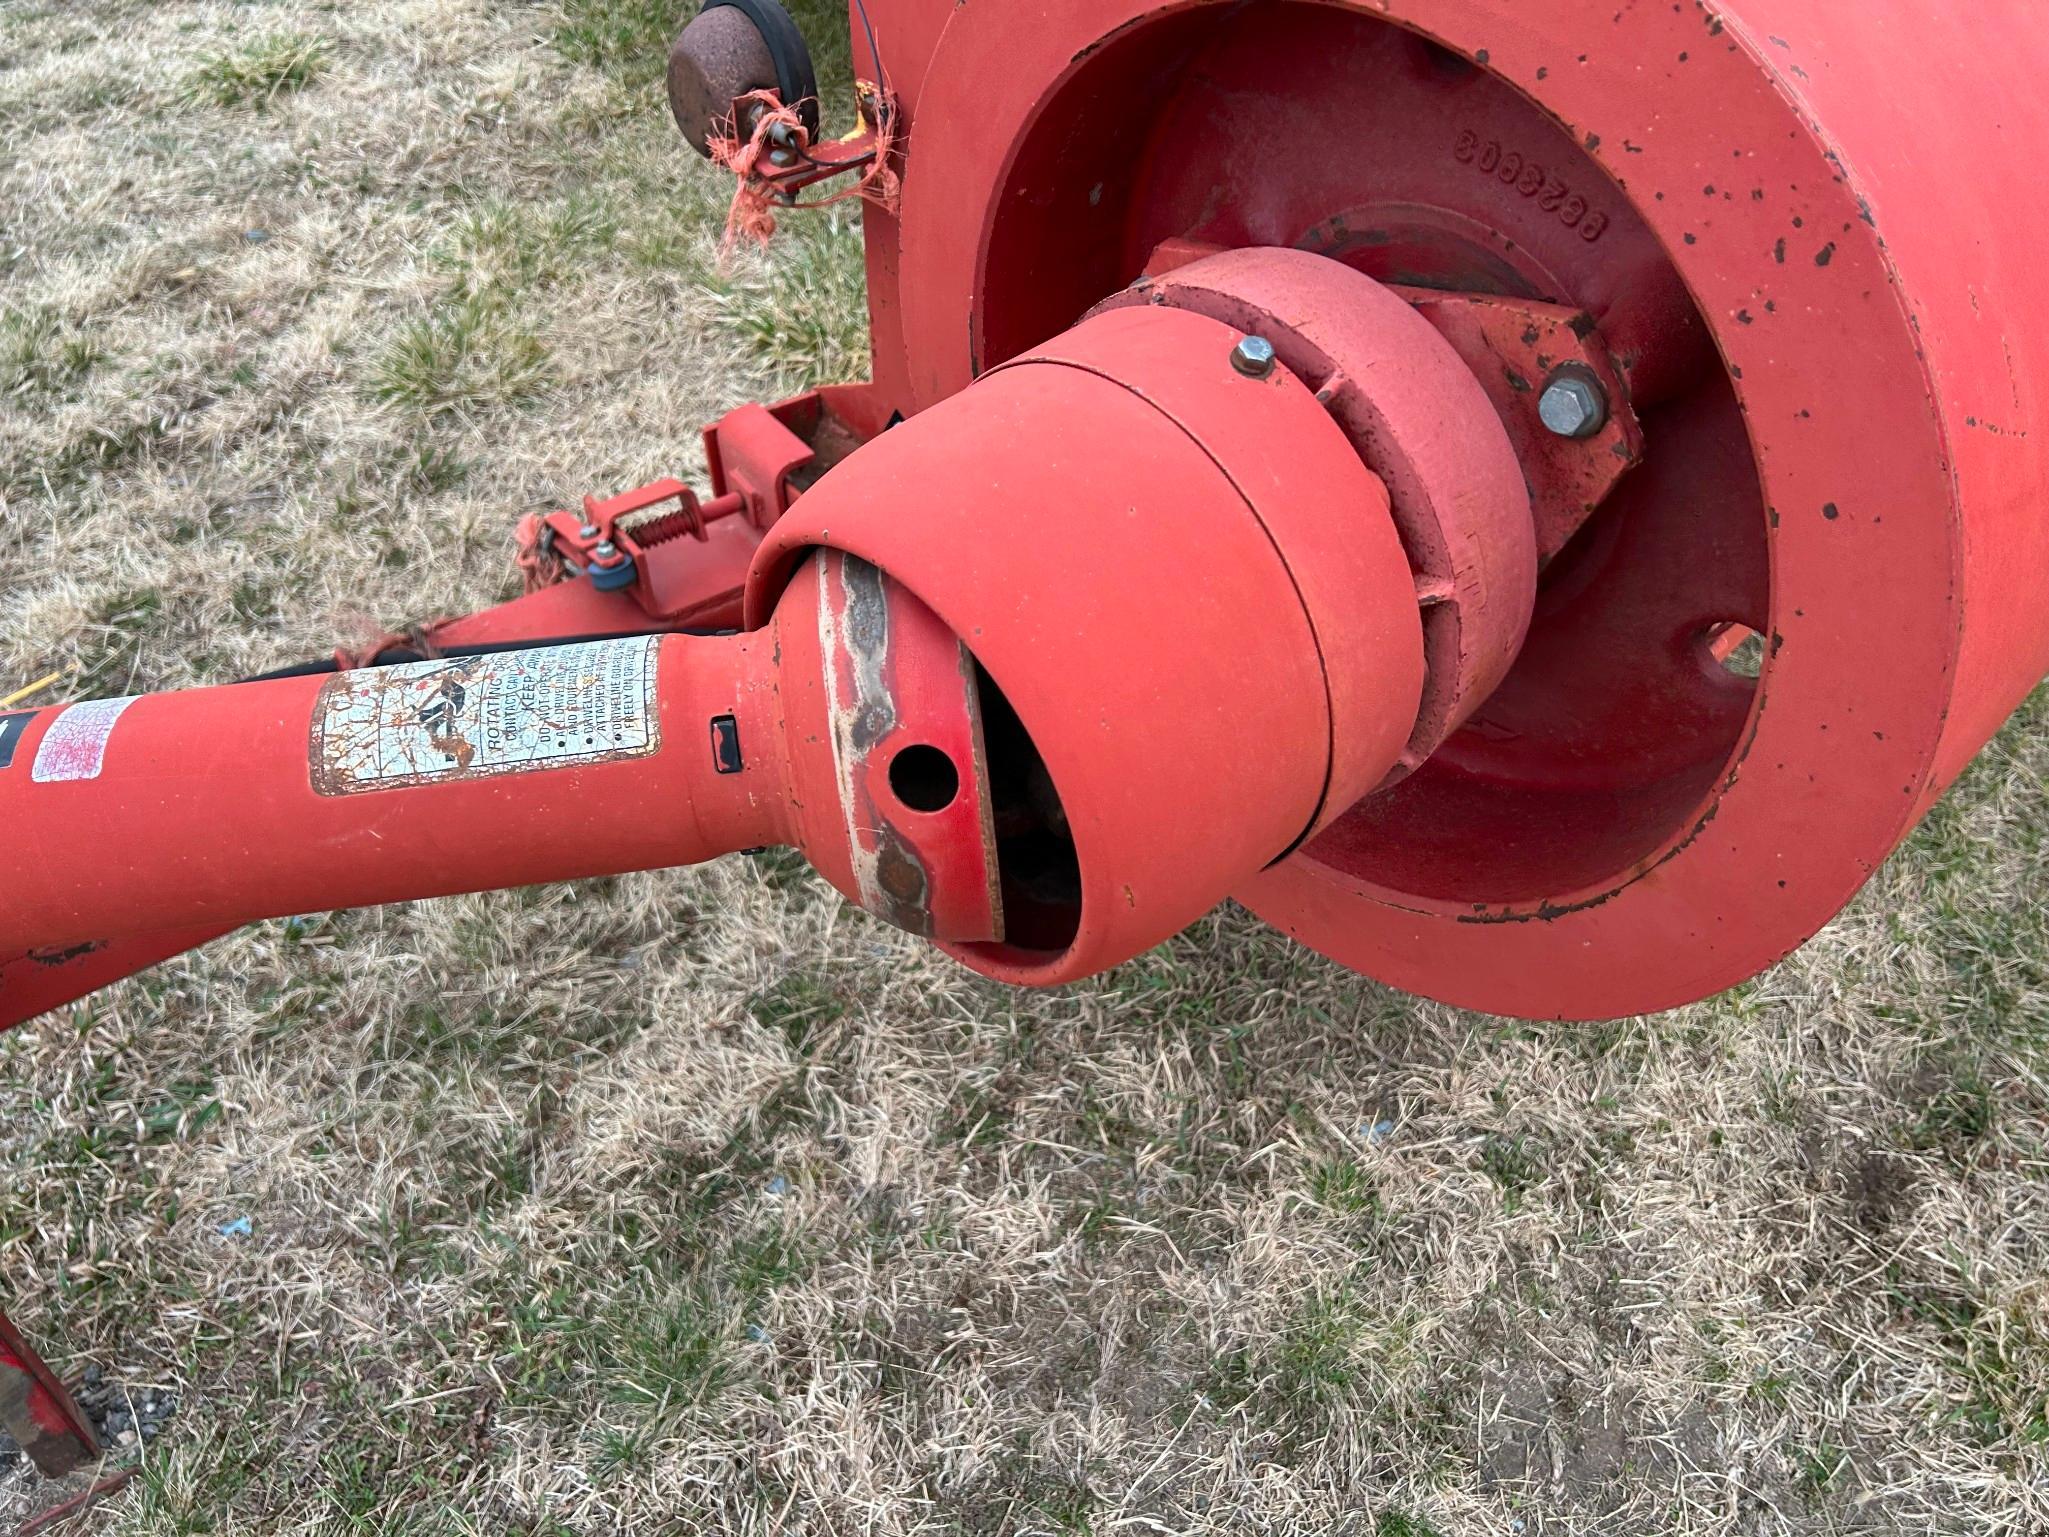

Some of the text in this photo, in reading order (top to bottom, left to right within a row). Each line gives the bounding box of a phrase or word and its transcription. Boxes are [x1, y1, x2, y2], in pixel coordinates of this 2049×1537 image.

[507, 673, 518, 690] CAN
[521, 674, 535, 711] KEEP
[540, 659, 553, 695] OPERATE
[623, 679, 634, 691] ON
[486, 677, 502, 750] ROTATING
[505, 693, 517, 740] CONTACT
[539, 699, 551, 721] NOT
[583, 679, 594, 734] DRIVELINES
[595, 684, 606, 732] ATTACHED
[611, 681, 622, 730] DRIVELINE
[623, 695, 634, 728] FREELY
[540, 727, 551, 742] DO
[568, 714, 578, 736] AND
